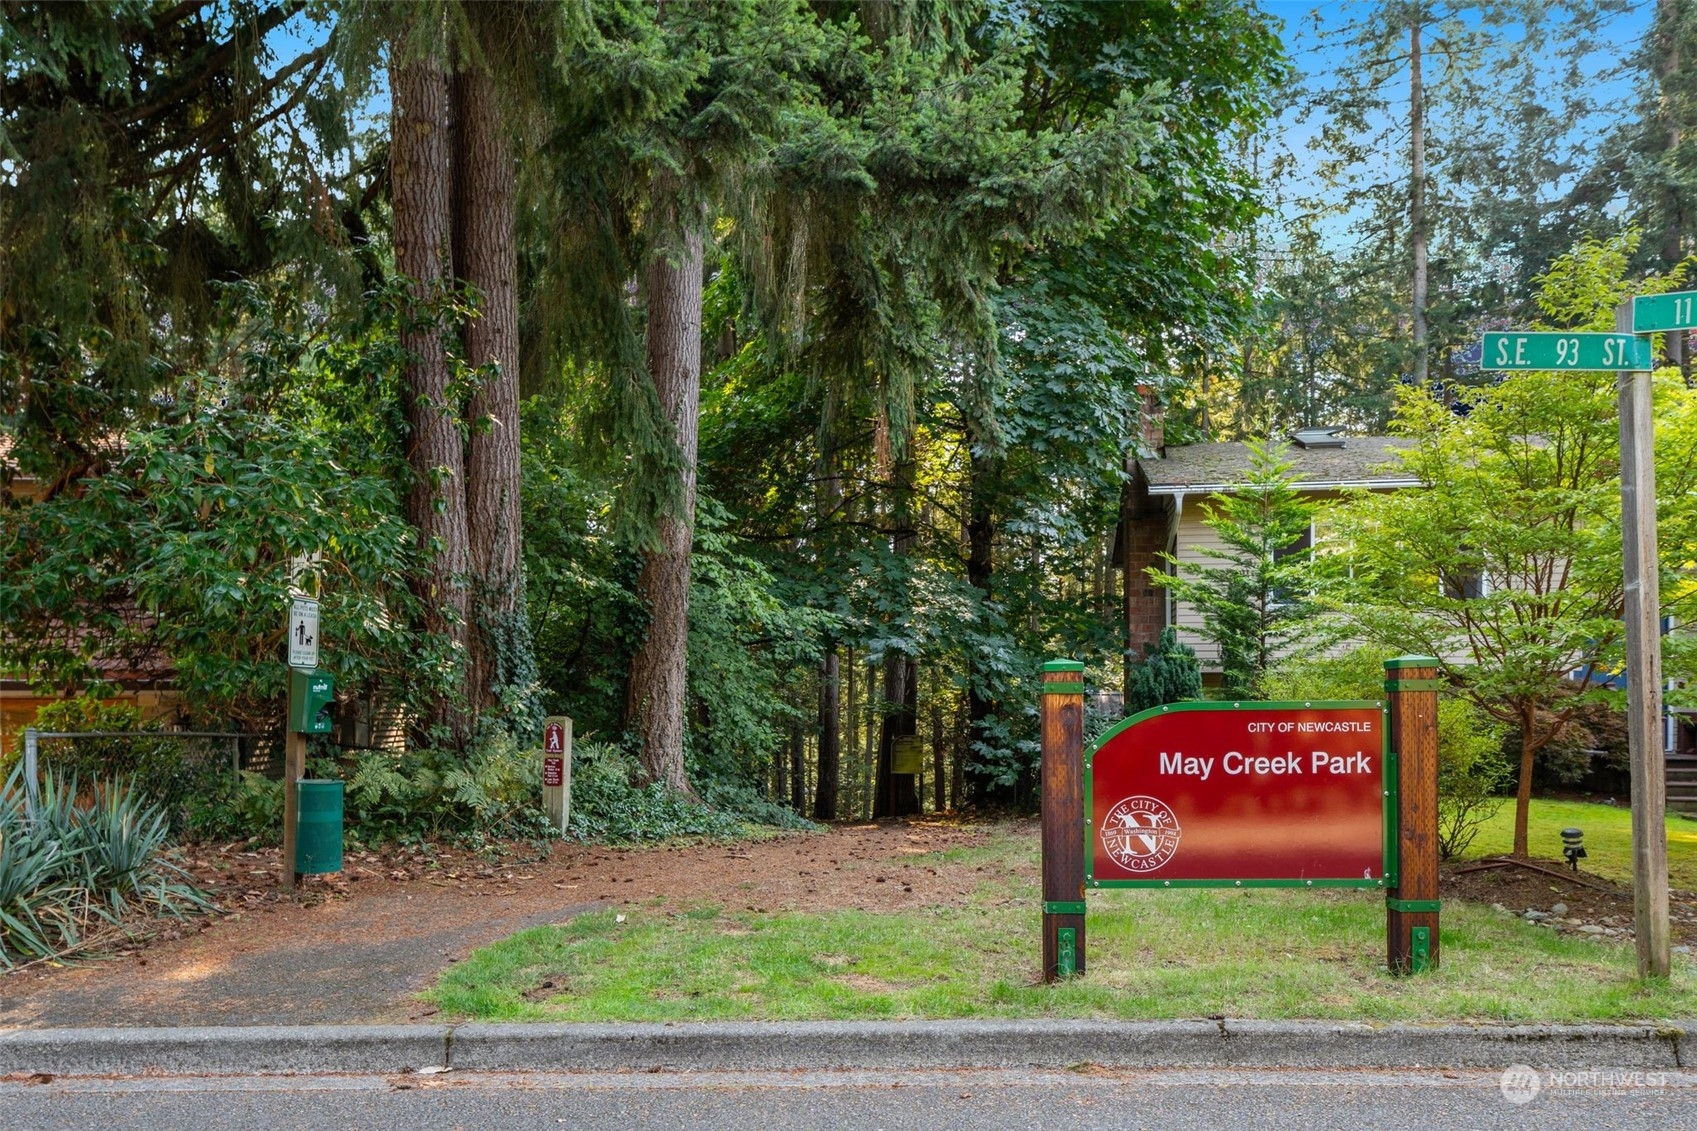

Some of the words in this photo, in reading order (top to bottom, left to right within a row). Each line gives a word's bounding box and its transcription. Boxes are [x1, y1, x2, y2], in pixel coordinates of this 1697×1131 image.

[1674, 297, 1697, 325] 11
[1496, 337, 1531, 366] S.E.
[1556, 338, 1580, 366] 93
[1602, 338, 1629, 366] ST.
[1247, 722, 1275, 733] CITY
[1278, 722, 1295, 733] OF
[1297, 721, 1371, 732] NEWCASTLE
[1160, 752, 1215, 781] May
[1223, 751, 1302, 775] Creek
[1311, 751, 1371, 774] Park
[1109, 804, 1130, 825] THE
[1131, 800, 1159, 812] CITY
[1158, 810, 1172, 824] OF
[1107, 839, 1175, 869] NEWCASTLE
